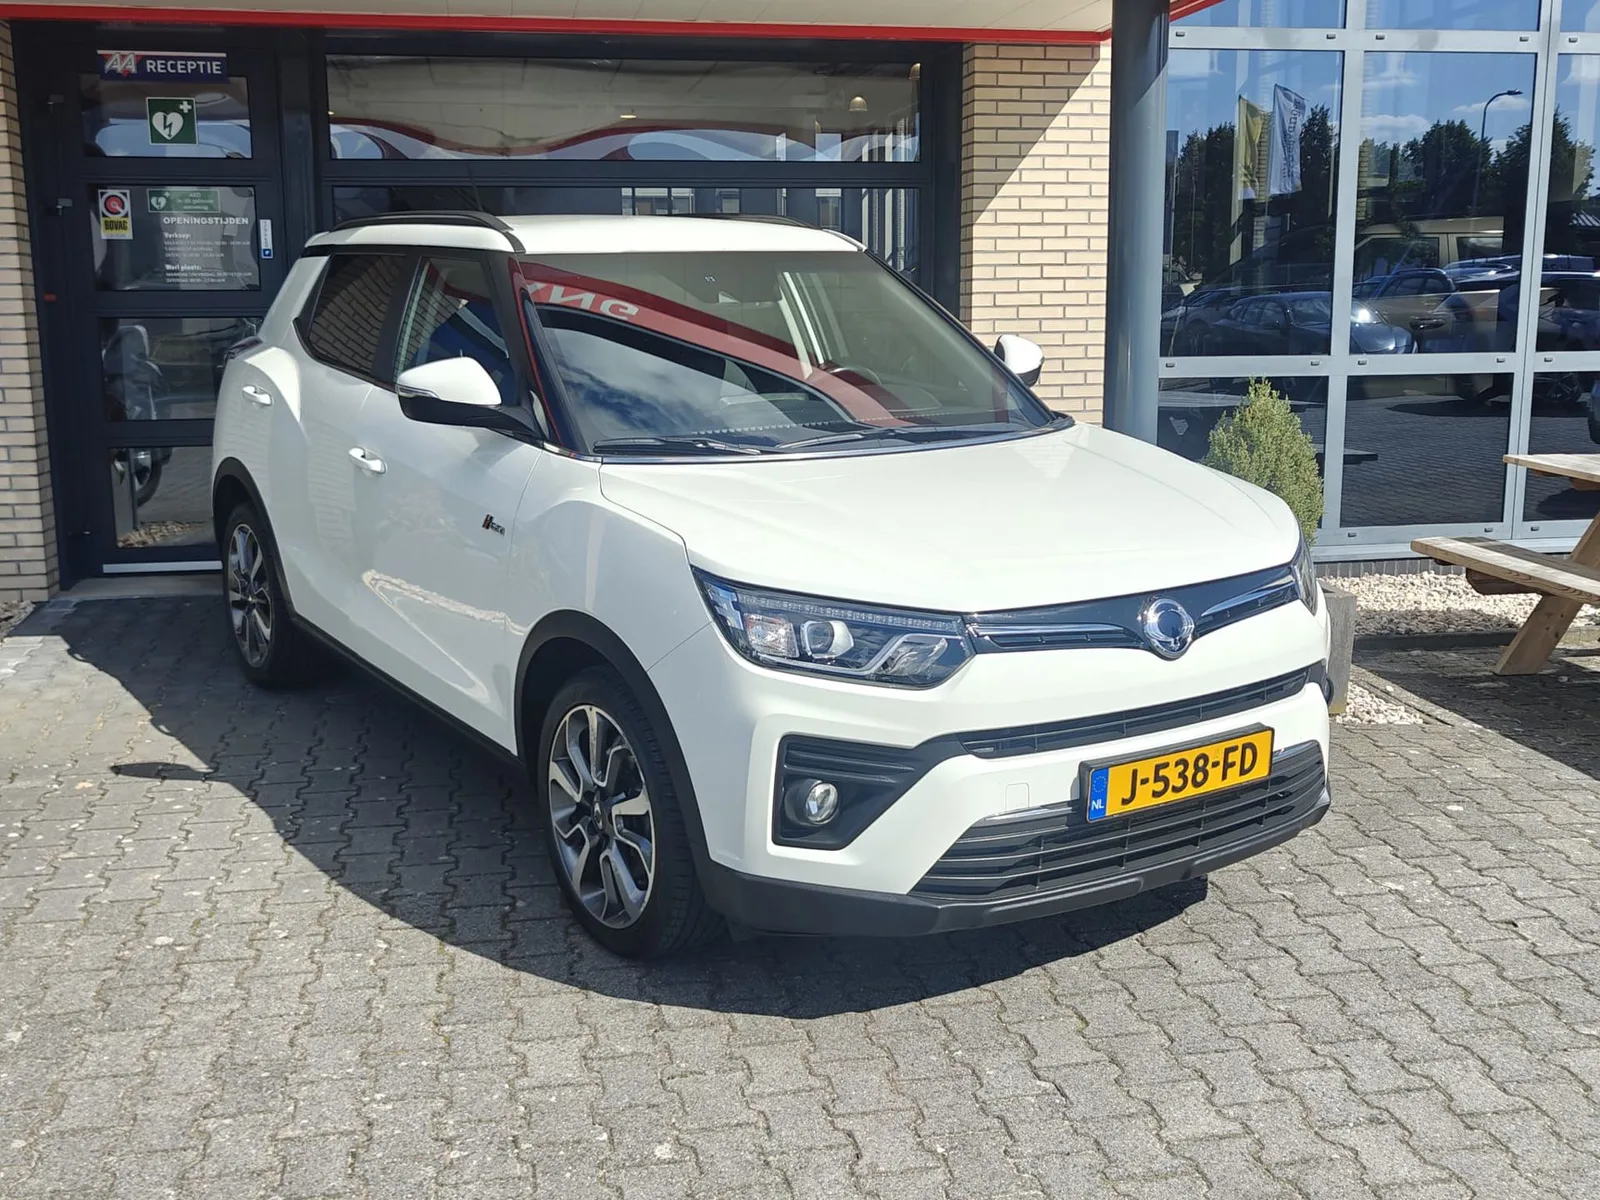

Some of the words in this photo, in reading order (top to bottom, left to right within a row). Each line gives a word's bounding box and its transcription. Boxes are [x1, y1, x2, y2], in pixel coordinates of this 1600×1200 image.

[146, 60, 222, 74] RECEPTIE
[163, 217, 249, 225] OPENINGSTIJDEN
[1121, 742, 1258, 806] J-538-FD
[1092, 798, 1104, 810] NL
